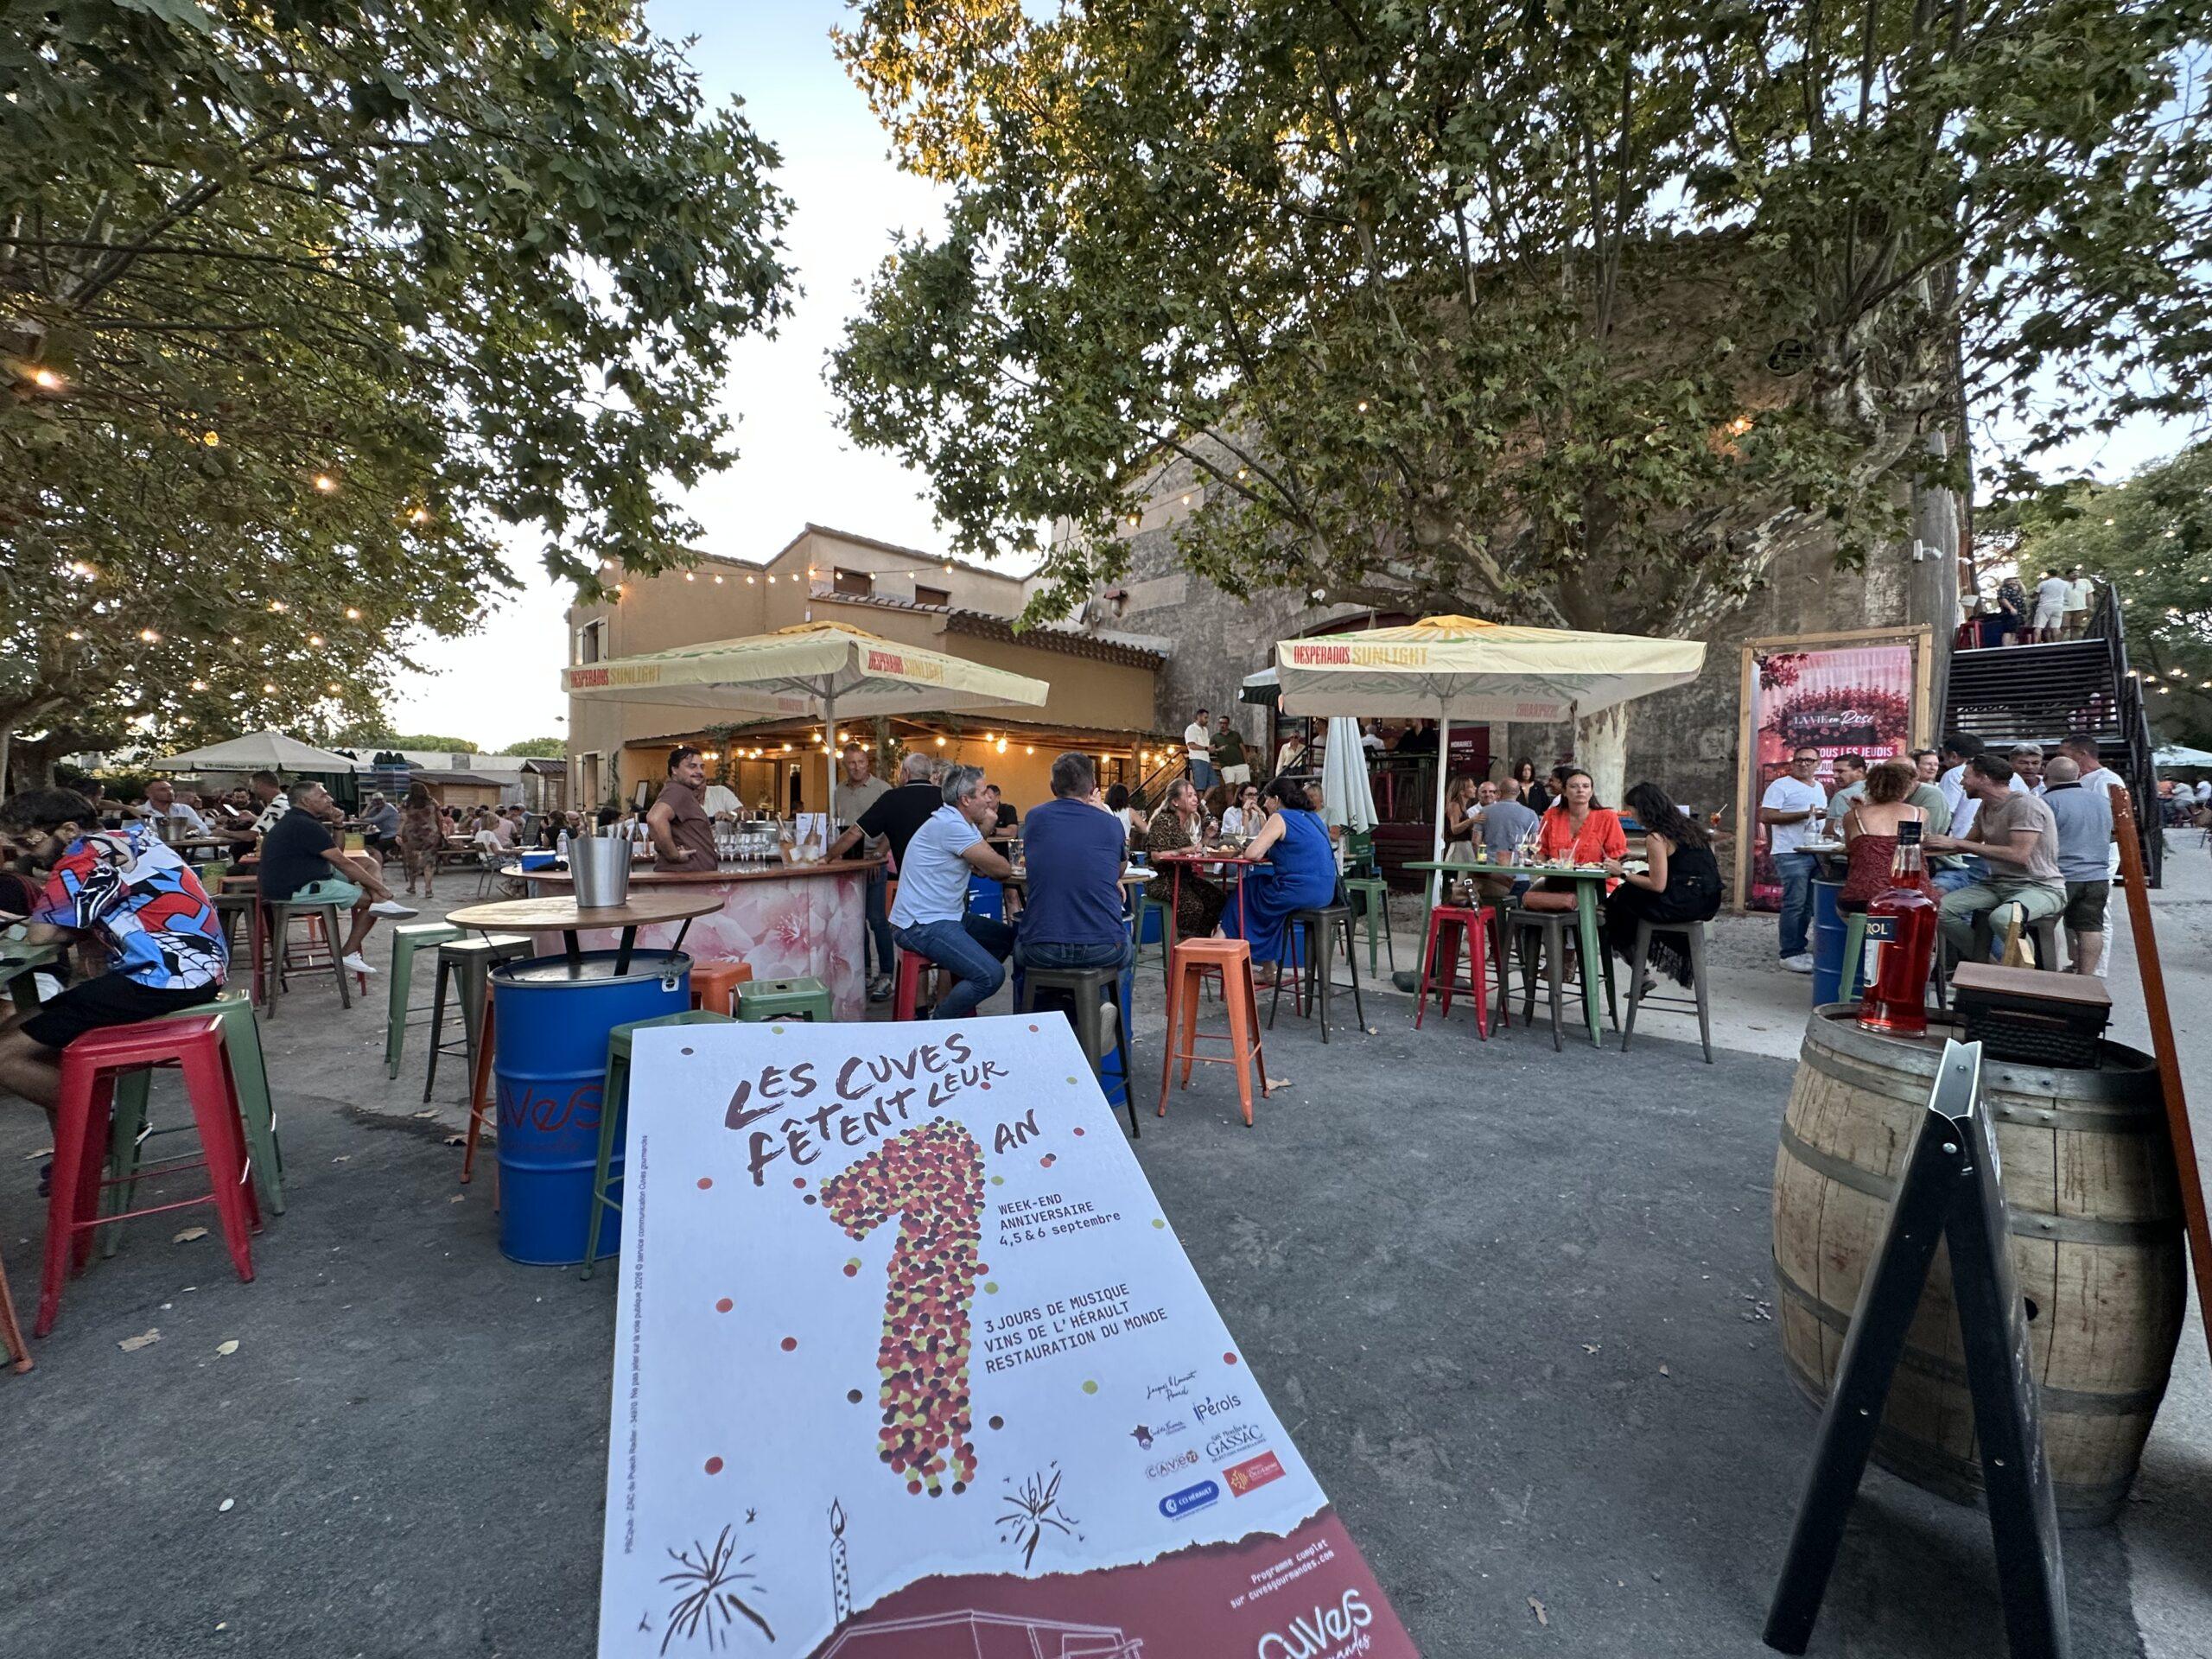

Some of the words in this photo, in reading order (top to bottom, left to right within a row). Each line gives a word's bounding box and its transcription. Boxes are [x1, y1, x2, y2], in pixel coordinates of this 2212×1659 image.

[868, 650, 904, 675] DESPERADOS
[904, 656, 944, 683] SUNLIGHT
[1294, 645, 1351, 664] DESPERADOS
[1351, 646, 1428, 665] SUNLIGHT
[570, 668, 609, 689] DESPERADOS
[609, 664, 662, 685] SUNLIGHT
[1861, 747, 1893, 757] JEUDIS
[724, 1062, 817, 1130] LES
[836, 1033, 971, 1101] CUVES
[747, 1087, 917, 1187] FÊTENT
[927, 1061, 1009, 1109] LEUR
[994, 1108, 1040, 1154] AN
[638, 1171, 646, 1190] Cuves
[637, 1191, 645, 1237] communication
[998, 1193, 1063, 1216] WEEK-END
[1000, 1201, 1095, 1231] ANNIVERSAIRE
[1000, 1233, 1022, 1247] 4,5
[1026, 1230, 1035, 1241] &
[1038, 1227, 1046, 1238] 6
[1052, 1212, 1122, 1236] septembre
[633, 1292, 643, 1319] publique
[984, 1319, 995, 1333] 3
[997, 1307, 1042, 1331] JOURS
[1046, 1300, 1065, 1317] DE
[1069, 1283, 1130, 1310] MUSIQUE
[983, 1332, 1023, 1353] VINS
[1028, 1325, 1048, 1341] DE
[985, 1329, 1096, 1374] RESTAURATION
[1100, 1323, 1120, 1338] DU
[1123, 1307, 1168, 1331] MONDE
[631, 1356, 641, 1371] jeter
[631, 1387, 639, 1399] Ne
[1193, 1394, 1242, 1425] Pérols
[1206, 1425, 1263, 1457] GASSAC
[1250, 1557, 1294, 1585] Programme
[1295, 1539, 1329, 1562] complet
[1230, 1595, 1244, 1609] sur
